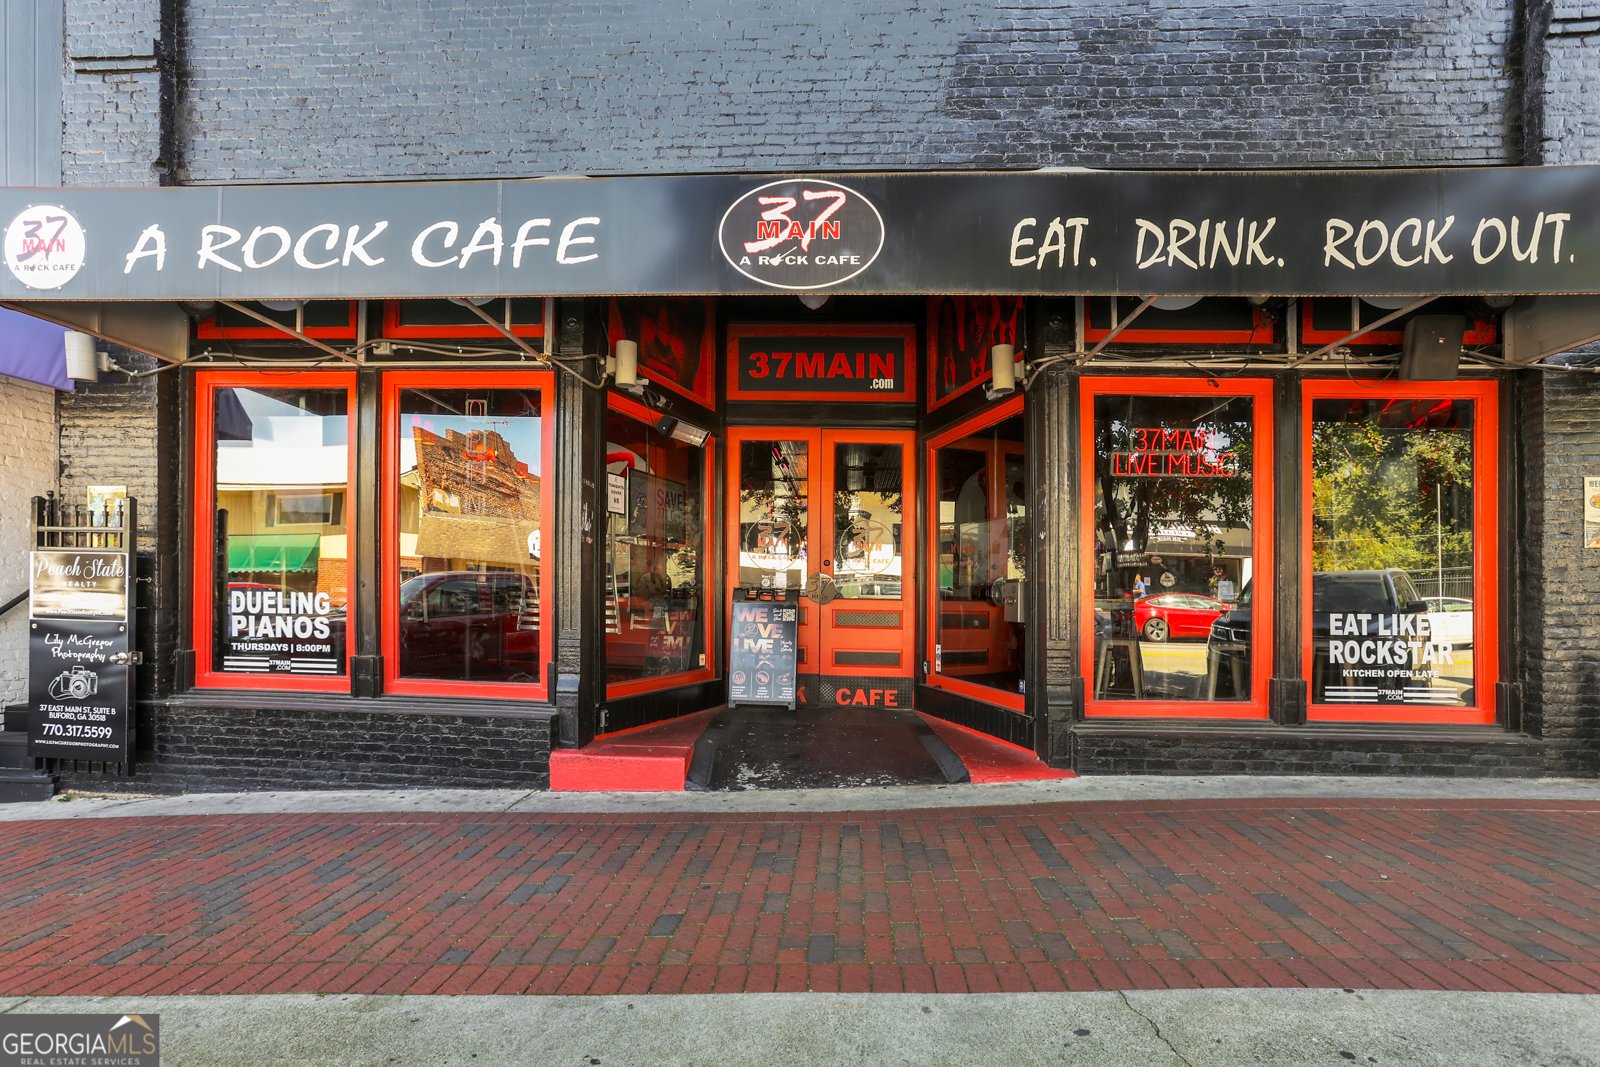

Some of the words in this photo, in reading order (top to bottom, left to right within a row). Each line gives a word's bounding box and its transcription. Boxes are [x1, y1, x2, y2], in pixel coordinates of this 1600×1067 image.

[743, 190, 847, 253] 37
[756, 220, 841, 239] MAIN
[16, 216, 68, 262] 37
[22, 239, 65, 252] MAIN
[124, 223, 167, 274] A
[196, 220, 389, 272] ROCK
[411, 217, 601, 269] CAFE
[1009, 216, 1097, 269] EAT.
[1135, 216, 1285, 269] DRINK.
[1323, 214, 1455, 270] ROCK
[1471, 211, 1575, 266] OUT.
[52, 263, 76, 271] CAFE
[739, 255, 752, 265] A
[814, 255, 861, 265] CAFE
[748, 351, 895, 379] 37MAIN
[869, 378, 894, 389] .com
[1135, 428, 1216, 452] 37MAIN
[1115, 453, 1159, 477] LIVE
[1167, 453, 1234, 477] MUSIC
[657, 488, 684, 512] SAVE
[753, 521, 790, 553] 37
[36, 556, 82, 579] Peach
[83, 558, 125, 580] State
[231, 590, 331, 615] DUELING
[736, 608, 769, 623] WE
[1329, 613, 1372, 636] EAT
[1378, 613, 1431, 636] LIKE
[231, 615, 331, 639] PIANOS
[44, 633, 64, 648] Lily
[230, 642, 289, 652] THURSDAYS
[295, 643, 331, 653] 8:00PM
[51, 646, 106, 663] Photography
[1329, 640, 1454, 665] ROCKSTAR
[1342, 669, 1385, 678] KITCHEN
[1386, 669, 1414, 678] OPEN
[1415, 670, 1440, 678] LATE
[835, 687, 898, 706] CAFE
[39, 704, 48, 712] 37
[48, 704, 65, 713] EAST
[64, 705, 82, 714] MAIN
[92, 707, 111, 715] SUITE
[76, 713, 87, 721] GA
[87, 714, 107, 722] 30518
[41, 723, 113, 739] 770.317.5599
